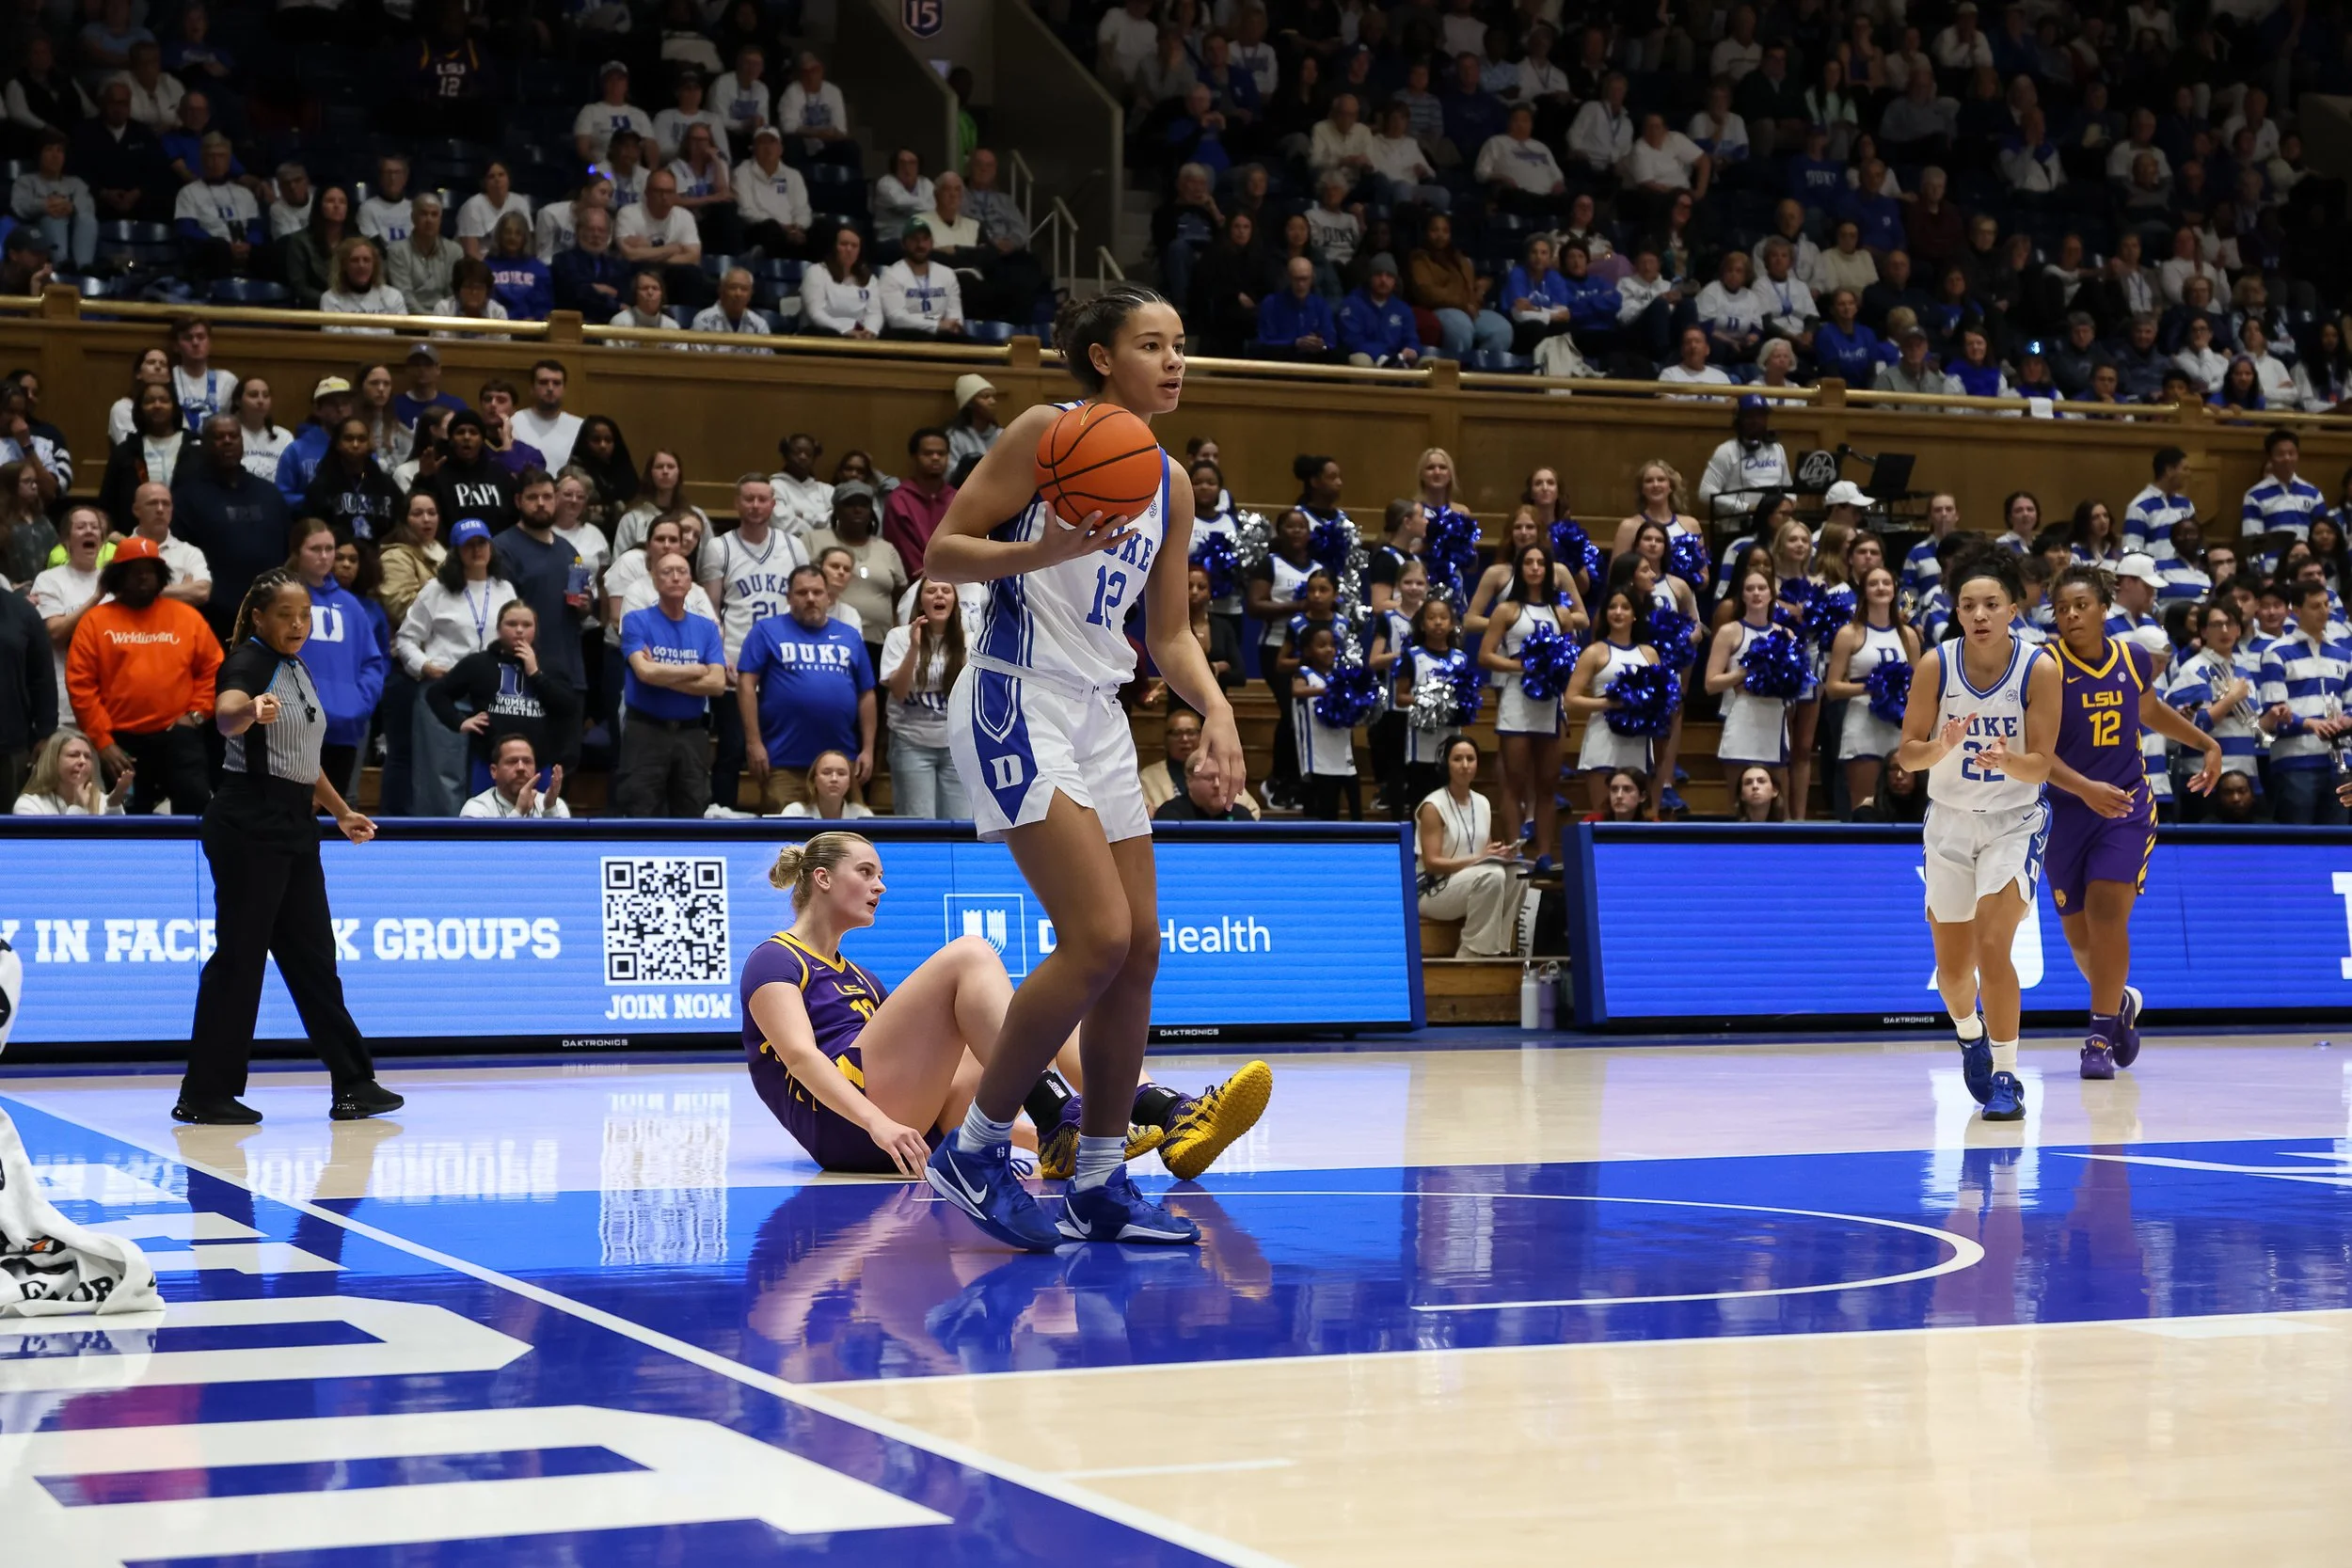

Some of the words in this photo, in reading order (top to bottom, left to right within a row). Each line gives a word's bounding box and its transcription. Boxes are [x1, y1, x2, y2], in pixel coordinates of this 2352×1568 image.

[910, 0, 938, 28] 15
[436, 62, 467, 76] LSU
[438, 76, 461, 98] 12
[1088, 525, 1153, 572] UKE
[736, 573, 788, 599] DUKE
[1086, 564, 1127, 631] 12
[752, 600, 777, 623] 21
[653, 645, 667, 657] GO
[667, 647, 678, 658] TO
[679, 648, 699, 659] HELL
[779, 641, 851, 667] DUKE
[2082, 690, 2123, 708] LSU
[1947, 713, 2017, 737] UKE
[2089, 709, 2121, 747] 12
[35, 919, 89, 963] IN
[103, 918, 360, 963] FACEK
[373, 917, 561, 960] GROUPS
[605, 993, 667, 1021] JOIN
[673, 993, 732, 1019] NOW
[1159, 1027, 1220, 1037] DAKTRONICS
[1883, 1016, 1935, 1024] DAKTRONICS
[562, 1038, 628, 1048] DAKTRONICS
